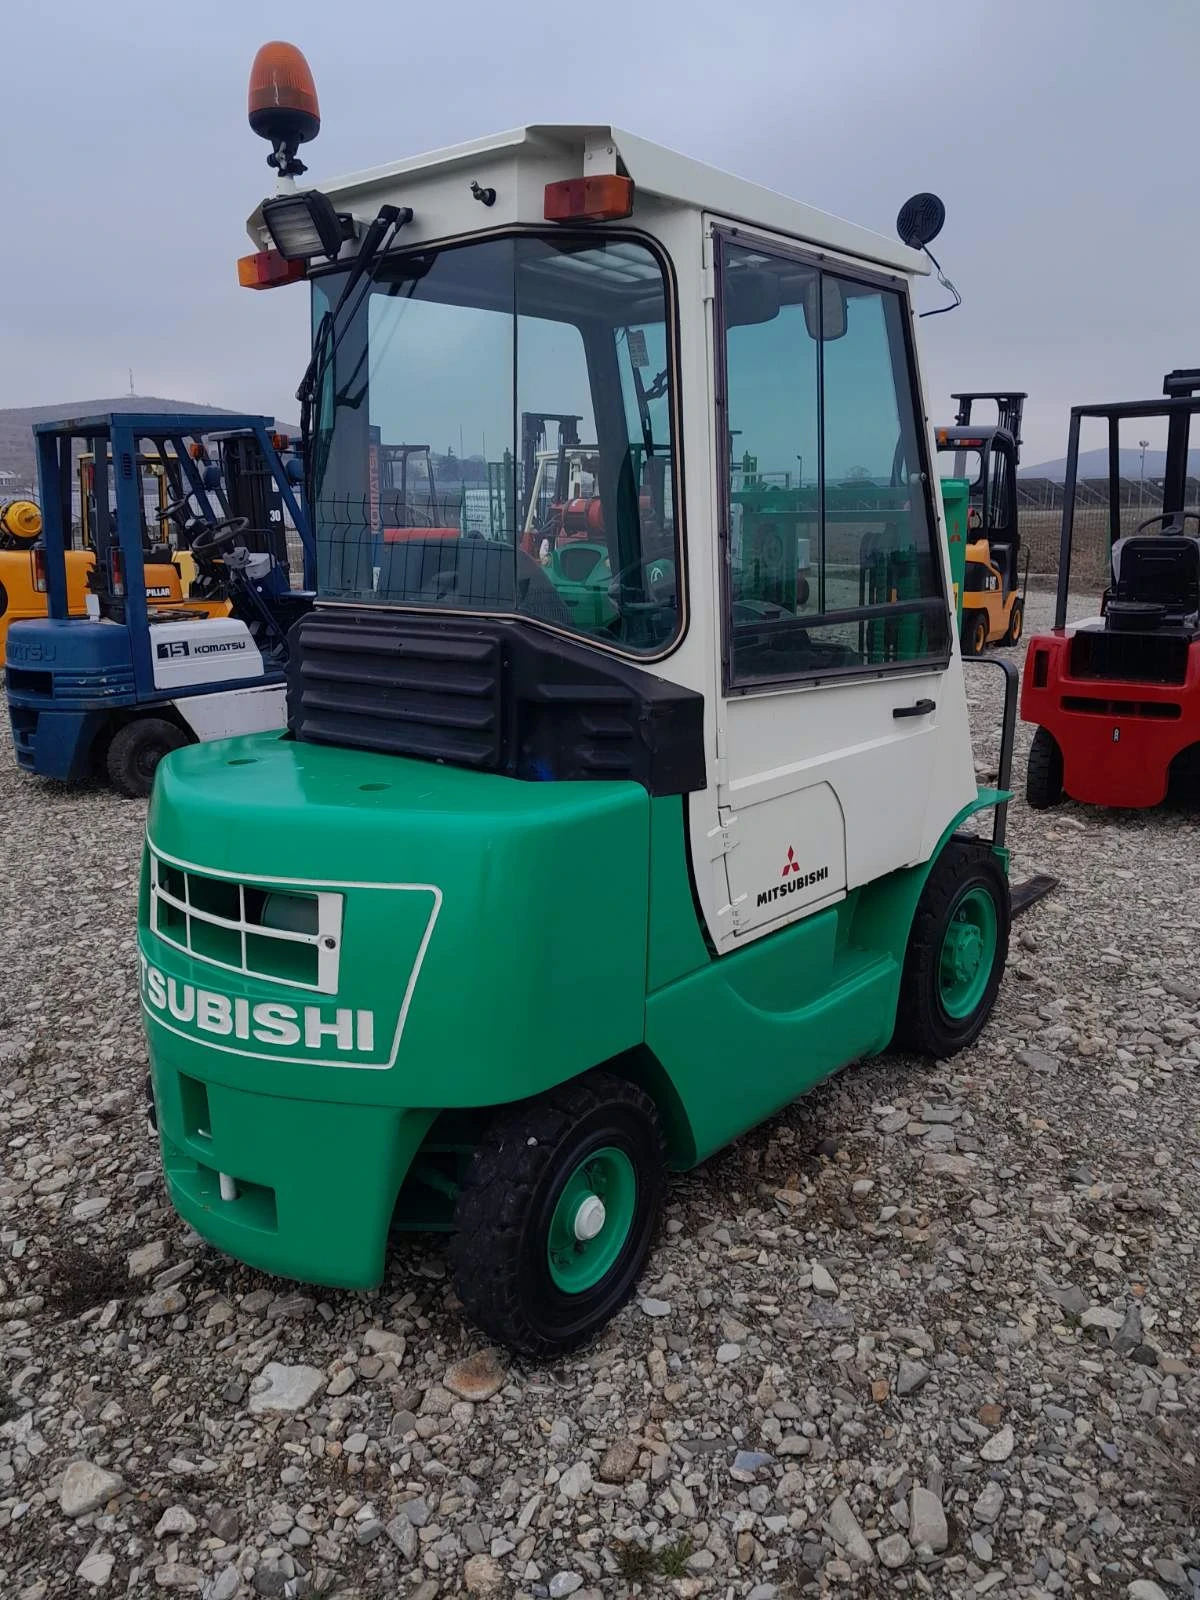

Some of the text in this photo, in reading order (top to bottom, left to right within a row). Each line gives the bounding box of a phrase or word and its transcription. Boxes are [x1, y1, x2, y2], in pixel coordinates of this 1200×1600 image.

[269, 509, 281, 522] 30
[158, 642, 188, 658] 15
[195, 641, 246, 654] KOMATSU
[756, 865, 829, 907] MITSUBISHI
